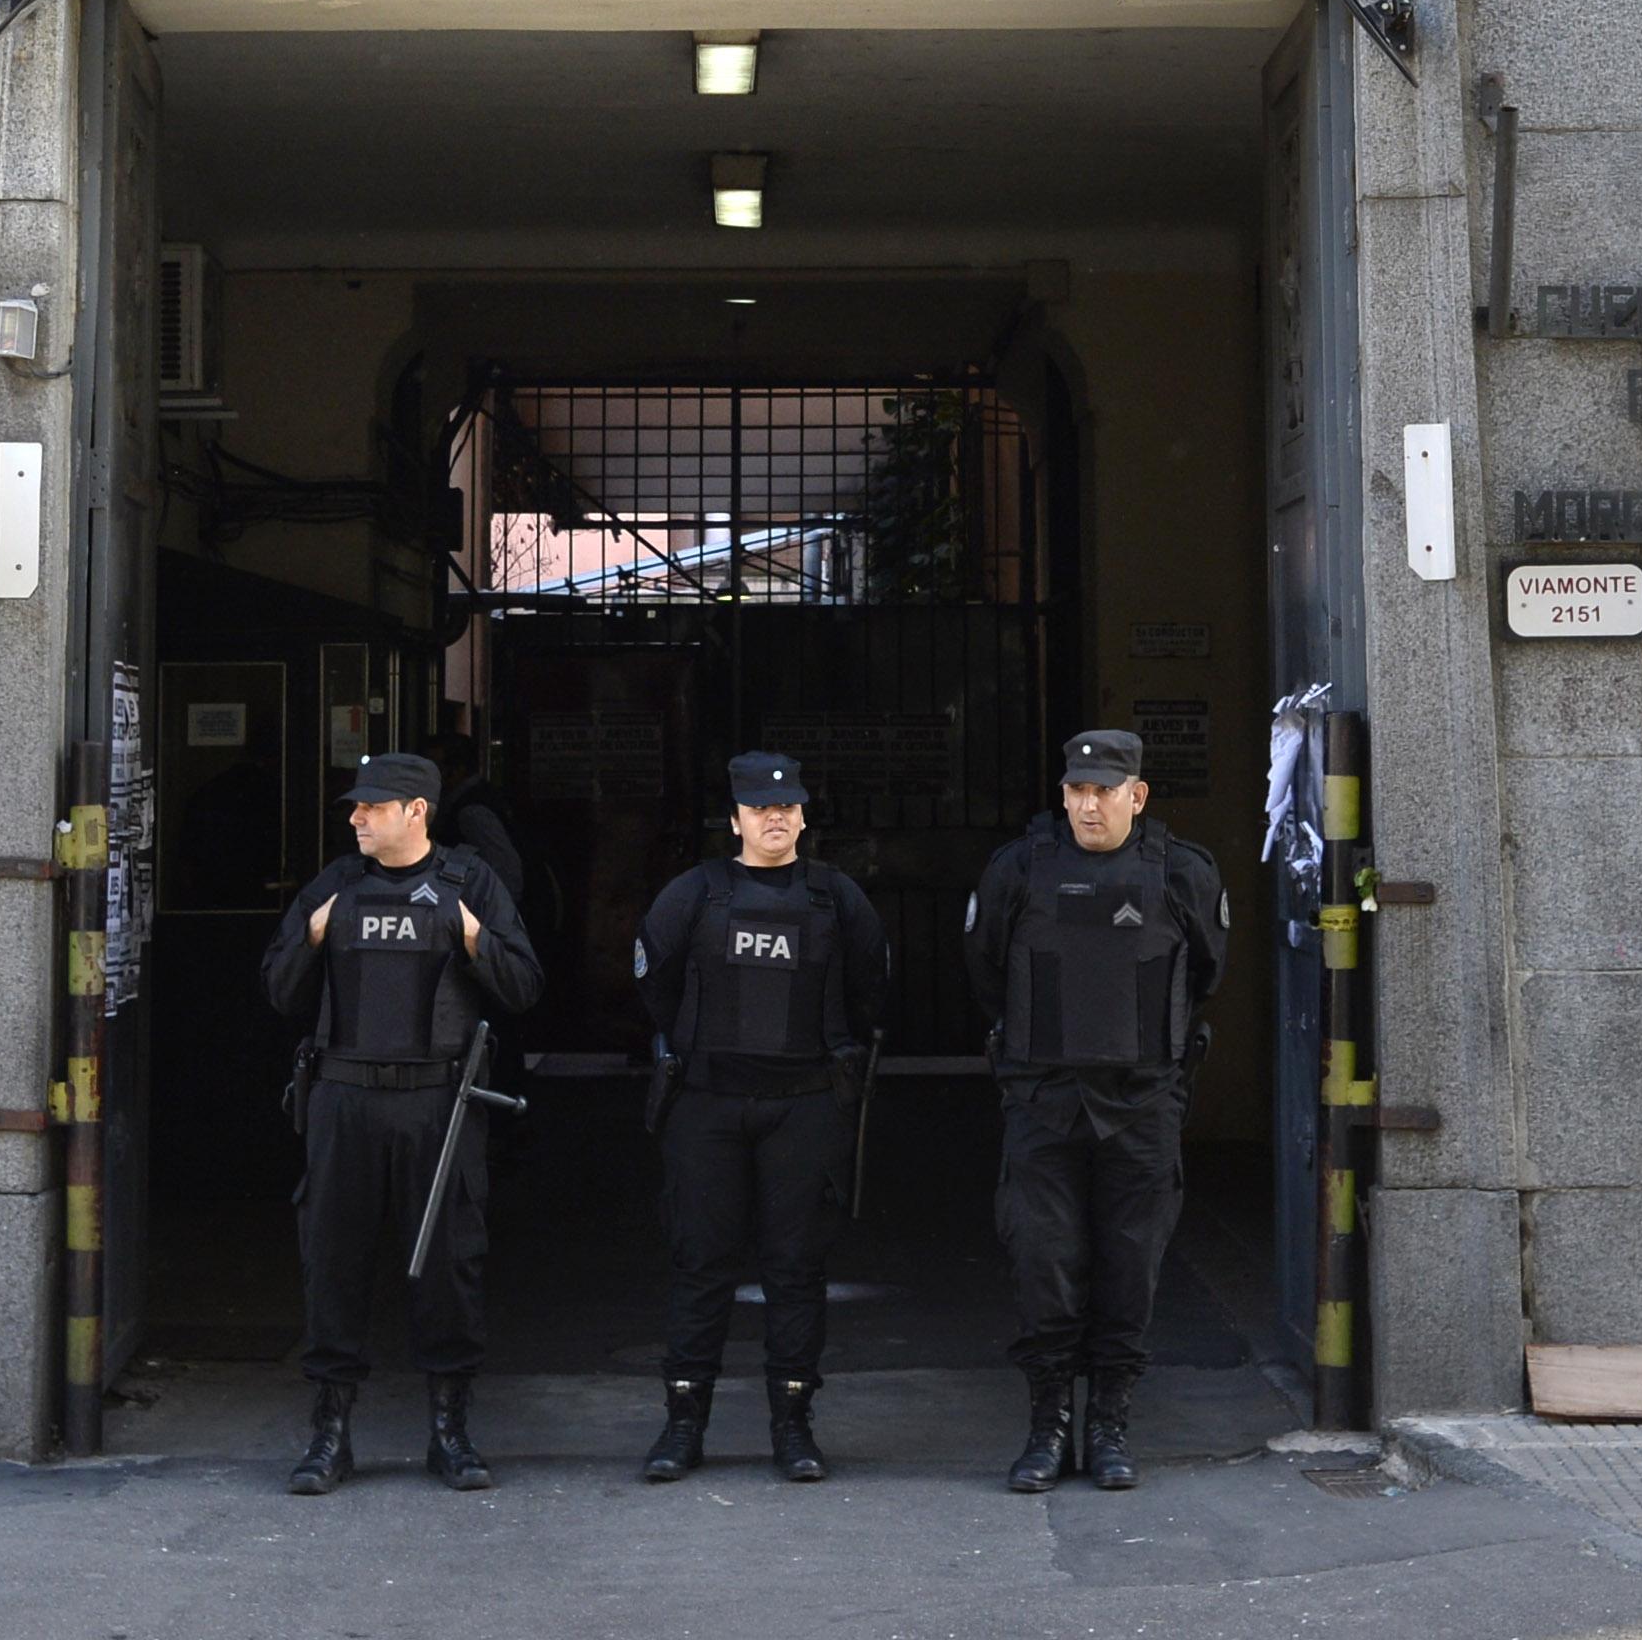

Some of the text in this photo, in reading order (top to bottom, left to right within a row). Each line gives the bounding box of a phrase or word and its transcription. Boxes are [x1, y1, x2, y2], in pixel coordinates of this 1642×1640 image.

[1519, 575, 1637, 595] VIAMONTE
[1551, 605, 1601, 623] 2151
[362, 916, 417, 940] PFA
[735, 931, 792, 960] PFA
